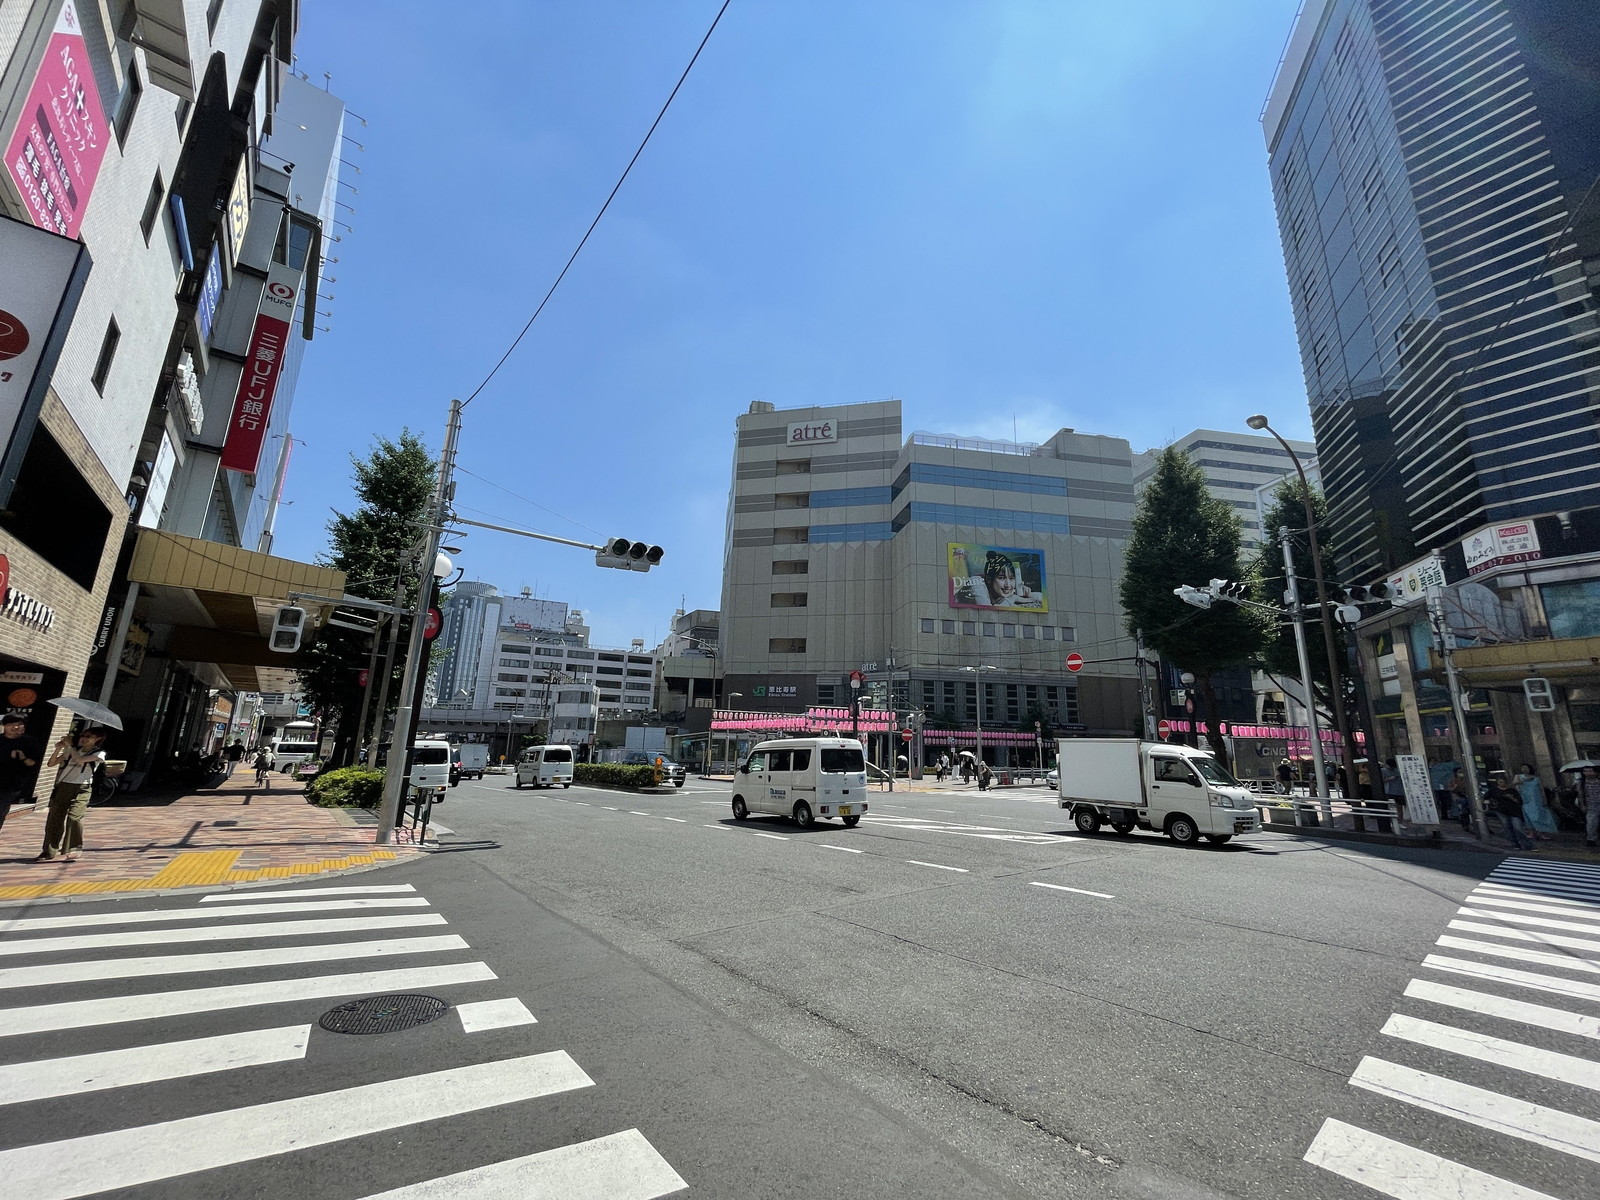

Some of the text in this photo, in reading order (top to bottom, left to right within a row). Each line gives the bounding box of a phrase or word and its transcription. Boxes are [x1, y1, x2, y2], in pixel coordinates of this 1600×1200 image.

[59, 85, 86, 152] クリニック
[266, 295, 292, 308] MUFG
[238, 332, 280, 431] 三菱UFJ銀行
[793, 422, 832, 441] atré
[1468, 552, 1541, 576] 0120-027-010
[952, 576, 985, 588] Diane
[98, 606, 116, 648] CURRY UDON
[861, 661, 877, 671] atré
